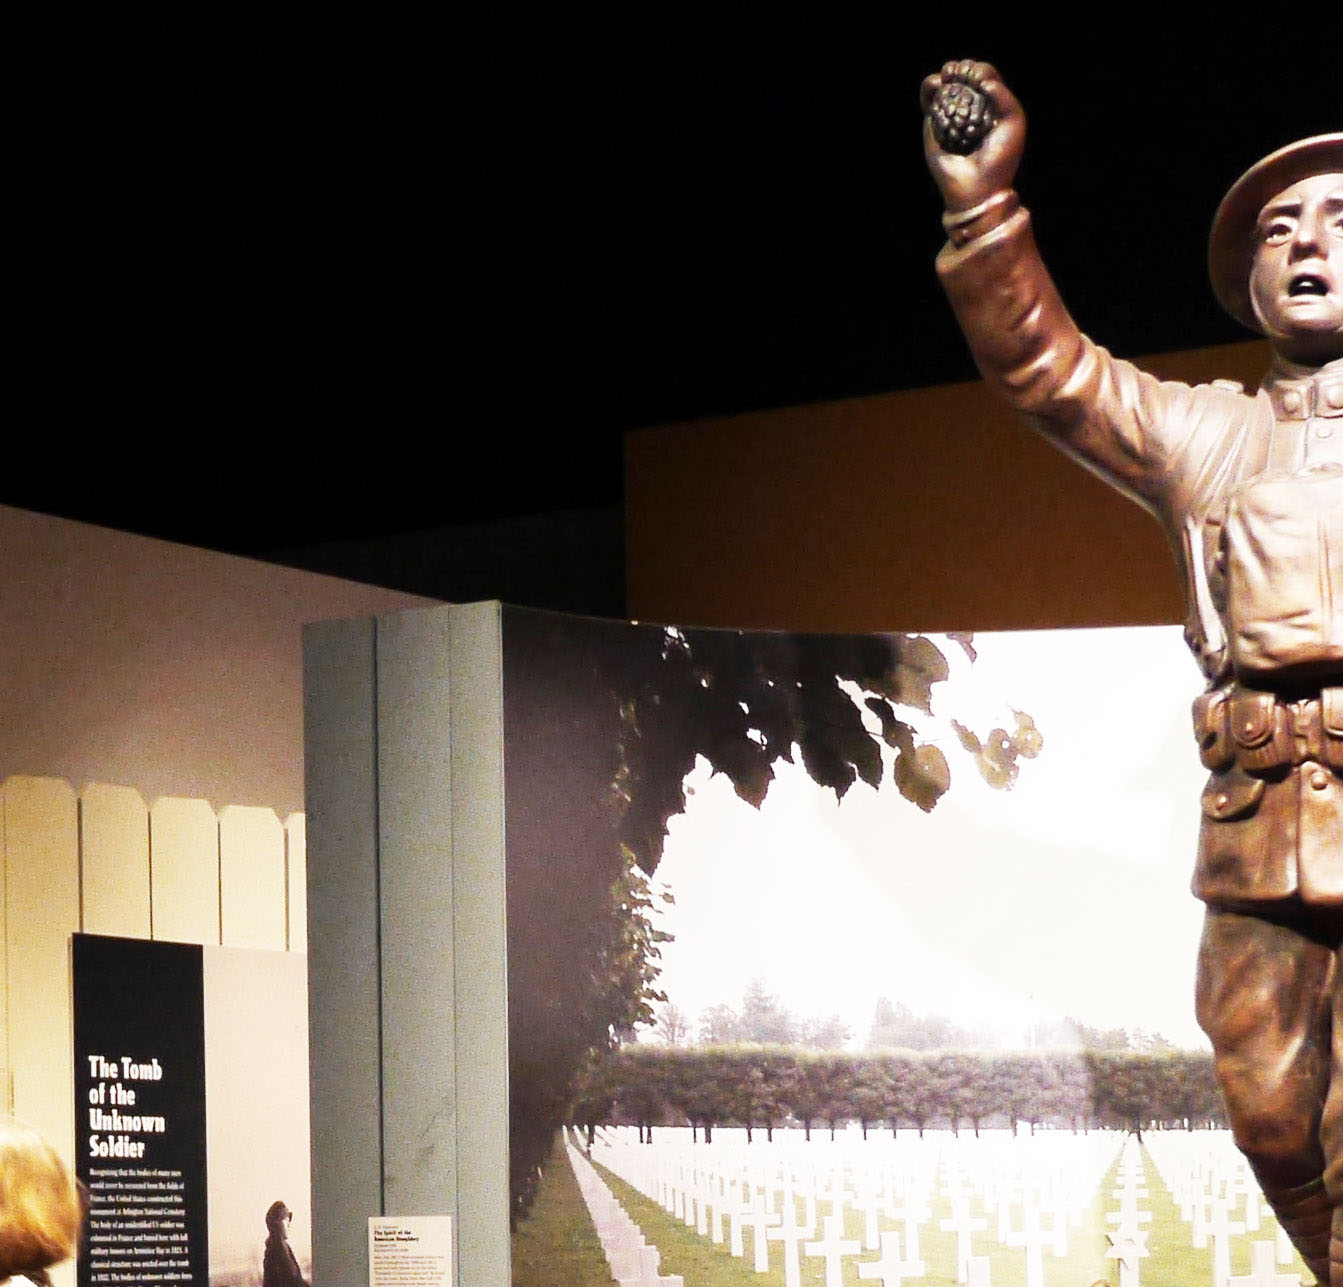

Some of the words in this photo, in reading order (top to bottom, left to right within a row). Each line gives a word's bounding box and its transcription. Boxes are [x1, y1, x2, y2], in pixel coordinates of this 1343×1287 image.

[88, 1056, 118, 1078] The
[120, 1057, 162, 1080] Tomb
[89, 1083, 105, 1104] of
[110, 1083, 136, 1105] the
[88, 1109, 165, 1132] Unknown
[88, 1135, 145, 1157] Soldier
